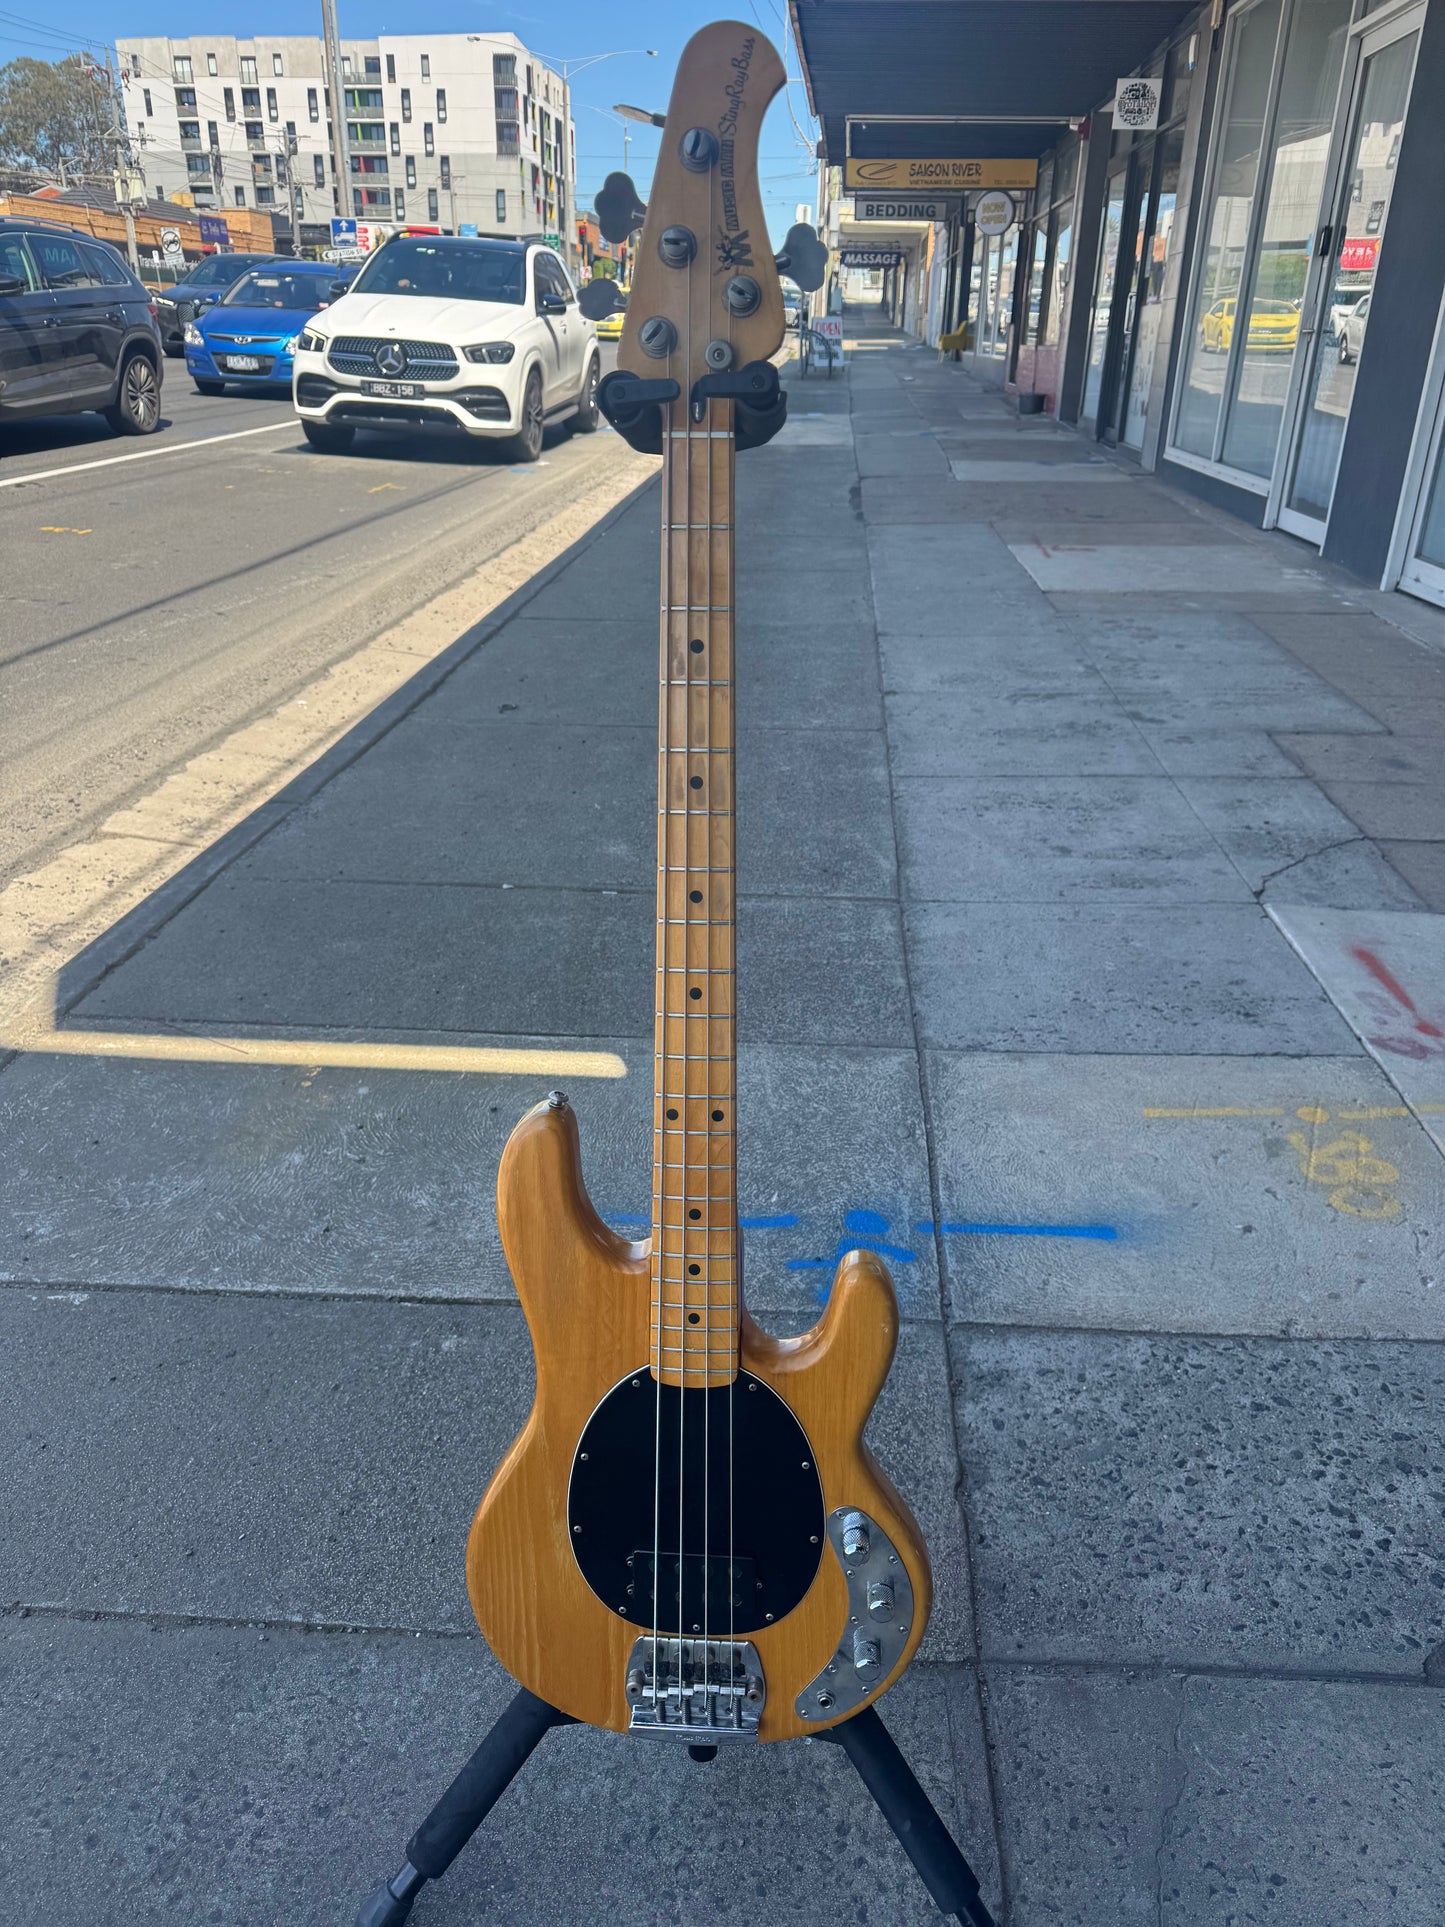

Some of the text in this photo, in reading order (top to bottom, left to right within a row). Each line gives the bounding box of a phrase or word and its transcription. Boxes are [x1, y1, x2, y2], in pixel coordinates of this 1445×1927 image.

[720, 140, 734, 178] MAN
[908, 162, 983, 177] SAIGON RIVER
[722, 181, 739, 231] MUSIC
[865, 203, 937, 218] BEDDING
[982, 201, 1006, 214] NOW
[844, 253, 898, 265] MASSAGE
[815, 321, 841, 336] OPEN
